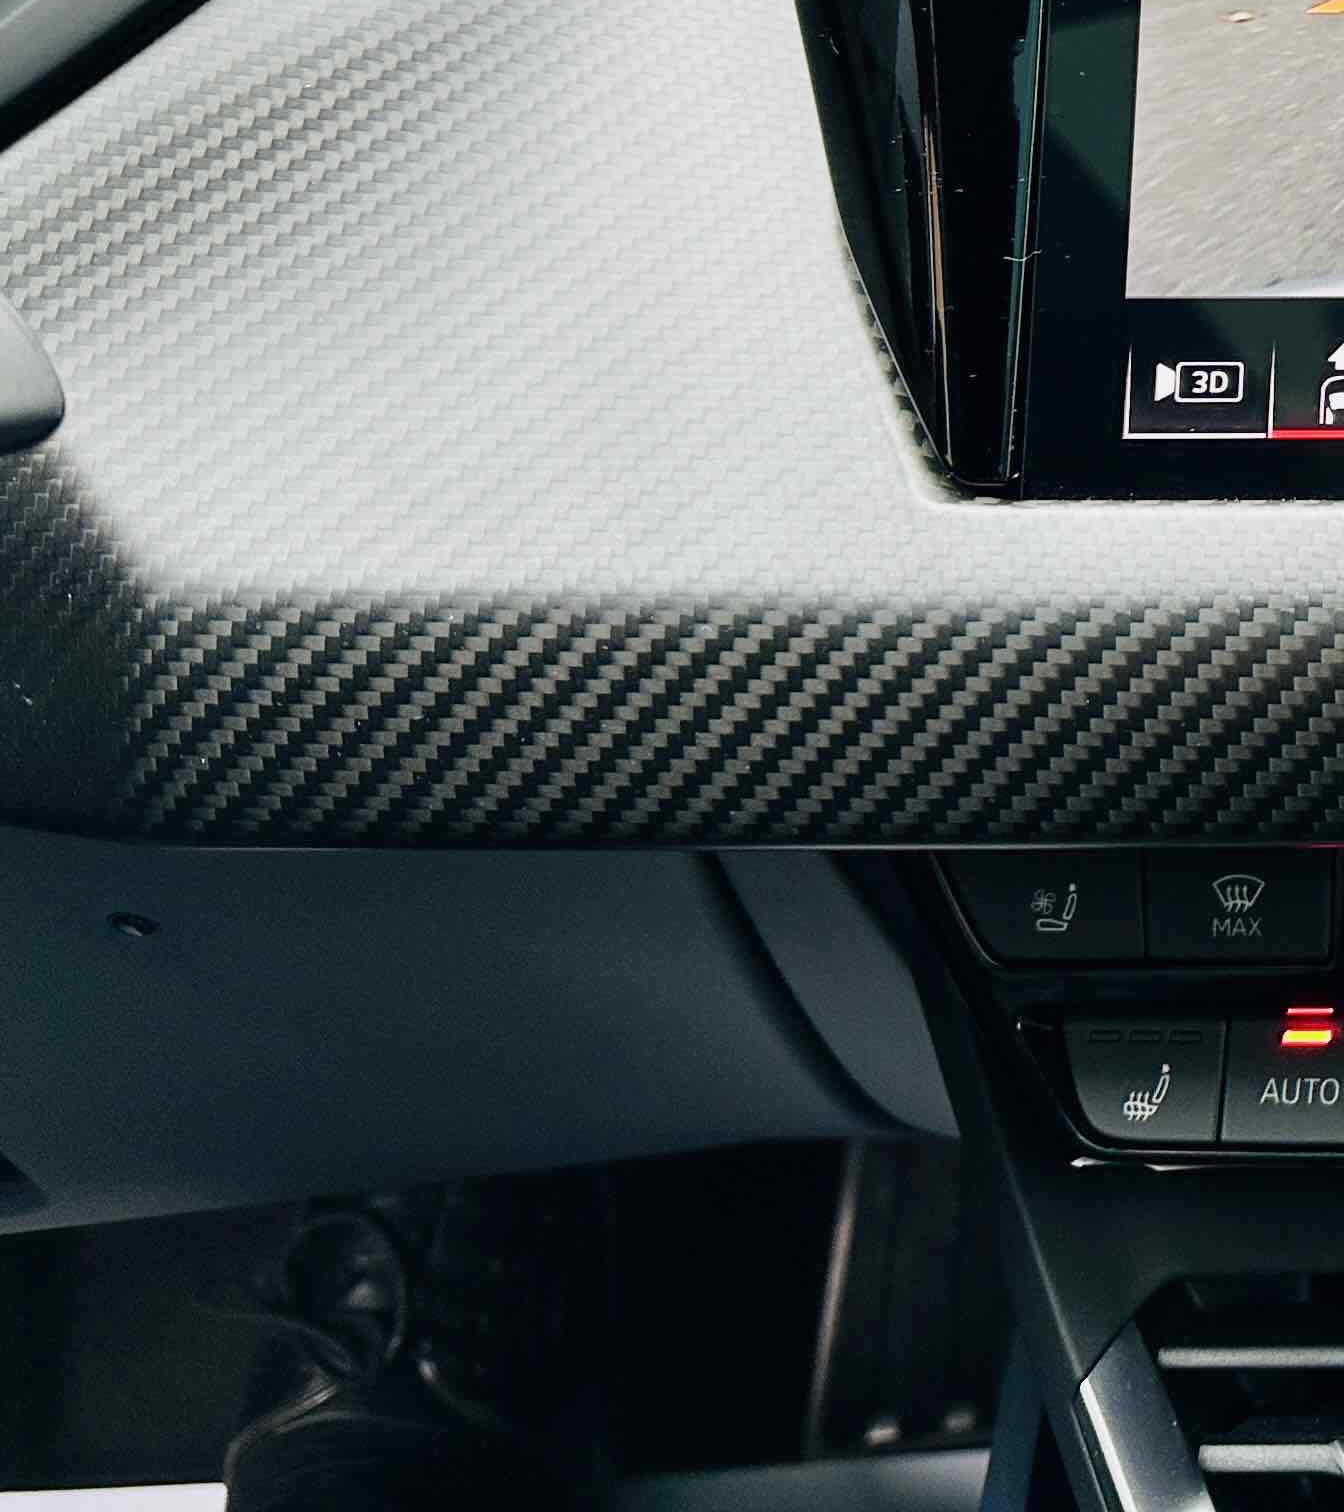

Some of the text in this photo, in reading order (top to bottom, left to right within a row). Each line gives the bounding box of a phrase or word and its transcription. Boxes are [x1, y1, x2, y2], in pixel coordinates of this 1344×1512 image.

[1191, 370, 1229, 394] 3D
[1211, 919, 1263, 938] MAX
[1259, 1077, 1340, 1107] AUTO
